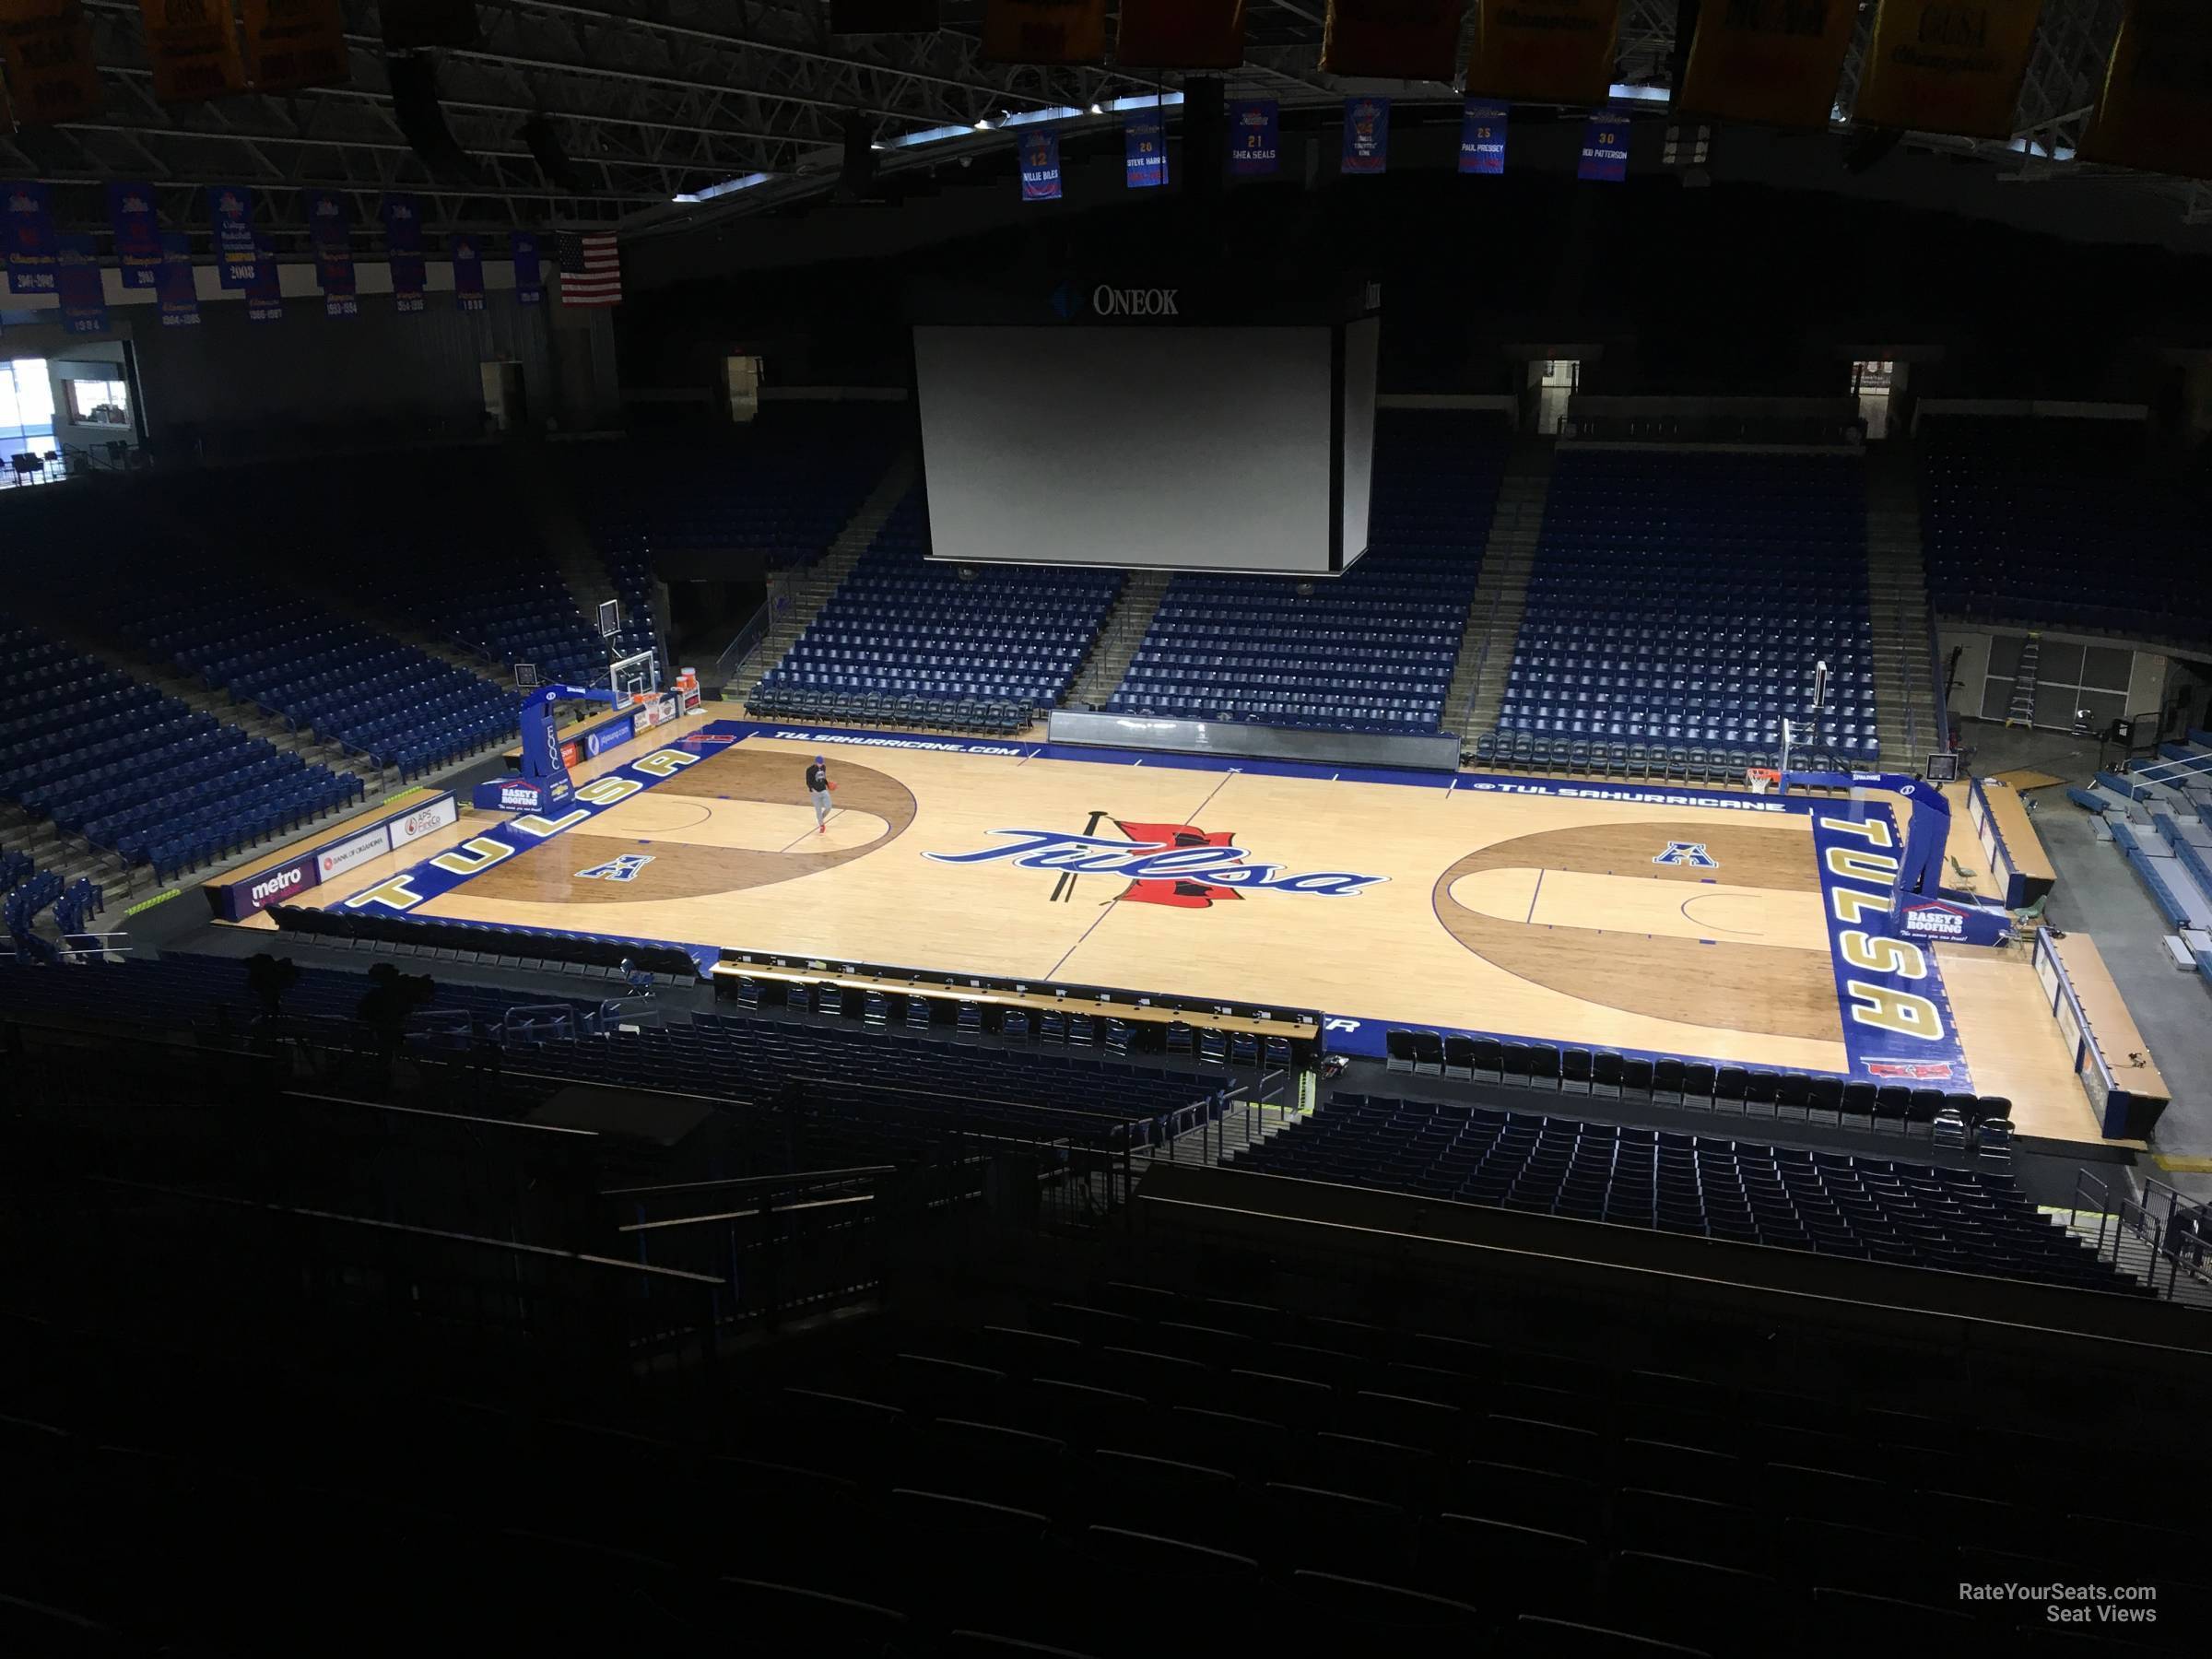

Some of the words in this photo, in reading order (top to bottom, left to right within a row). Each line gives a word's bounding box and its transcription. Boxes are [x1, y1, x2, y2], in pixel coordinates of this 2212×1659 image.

[1248, 135, 1262, 147] 21
[1598, 133, 1615, 145] 30
[1233, 149, 1252, 159] SHEA
[1253, 149, 1276, 159] SEALS
[1461, 144, 1477, 153] PAUL
[1477, 144, 1504, 153] PRESSEY
[1594, 148, 1628, 159] PATTERSON
[1030, 152, 1047, 167] 12
[1127, 158, 1145, 167] STEVE
[1042, 170, 1058, 181] BILES
[1093, 284, 1179, 316] ONEOK
[773, 730, 1021, 757] TULSAHURRICANE.COM
[501, 788, 538, 799] BASEY'S
[1473, 782, 1787, 812] @TULSAHURRICANE
[501, 795, 538, 806] ROOFING
[345, 748, 700, 910] TULSA
[920, 828, 1393, 897] Tulsa
[252, 868, 301, 900] metro
[1908, 911, 1963, 925] BASEY'S
[1820, 817, 1945, 1041] TULSA
[1907, 921, 1962, 934] ROOFING
